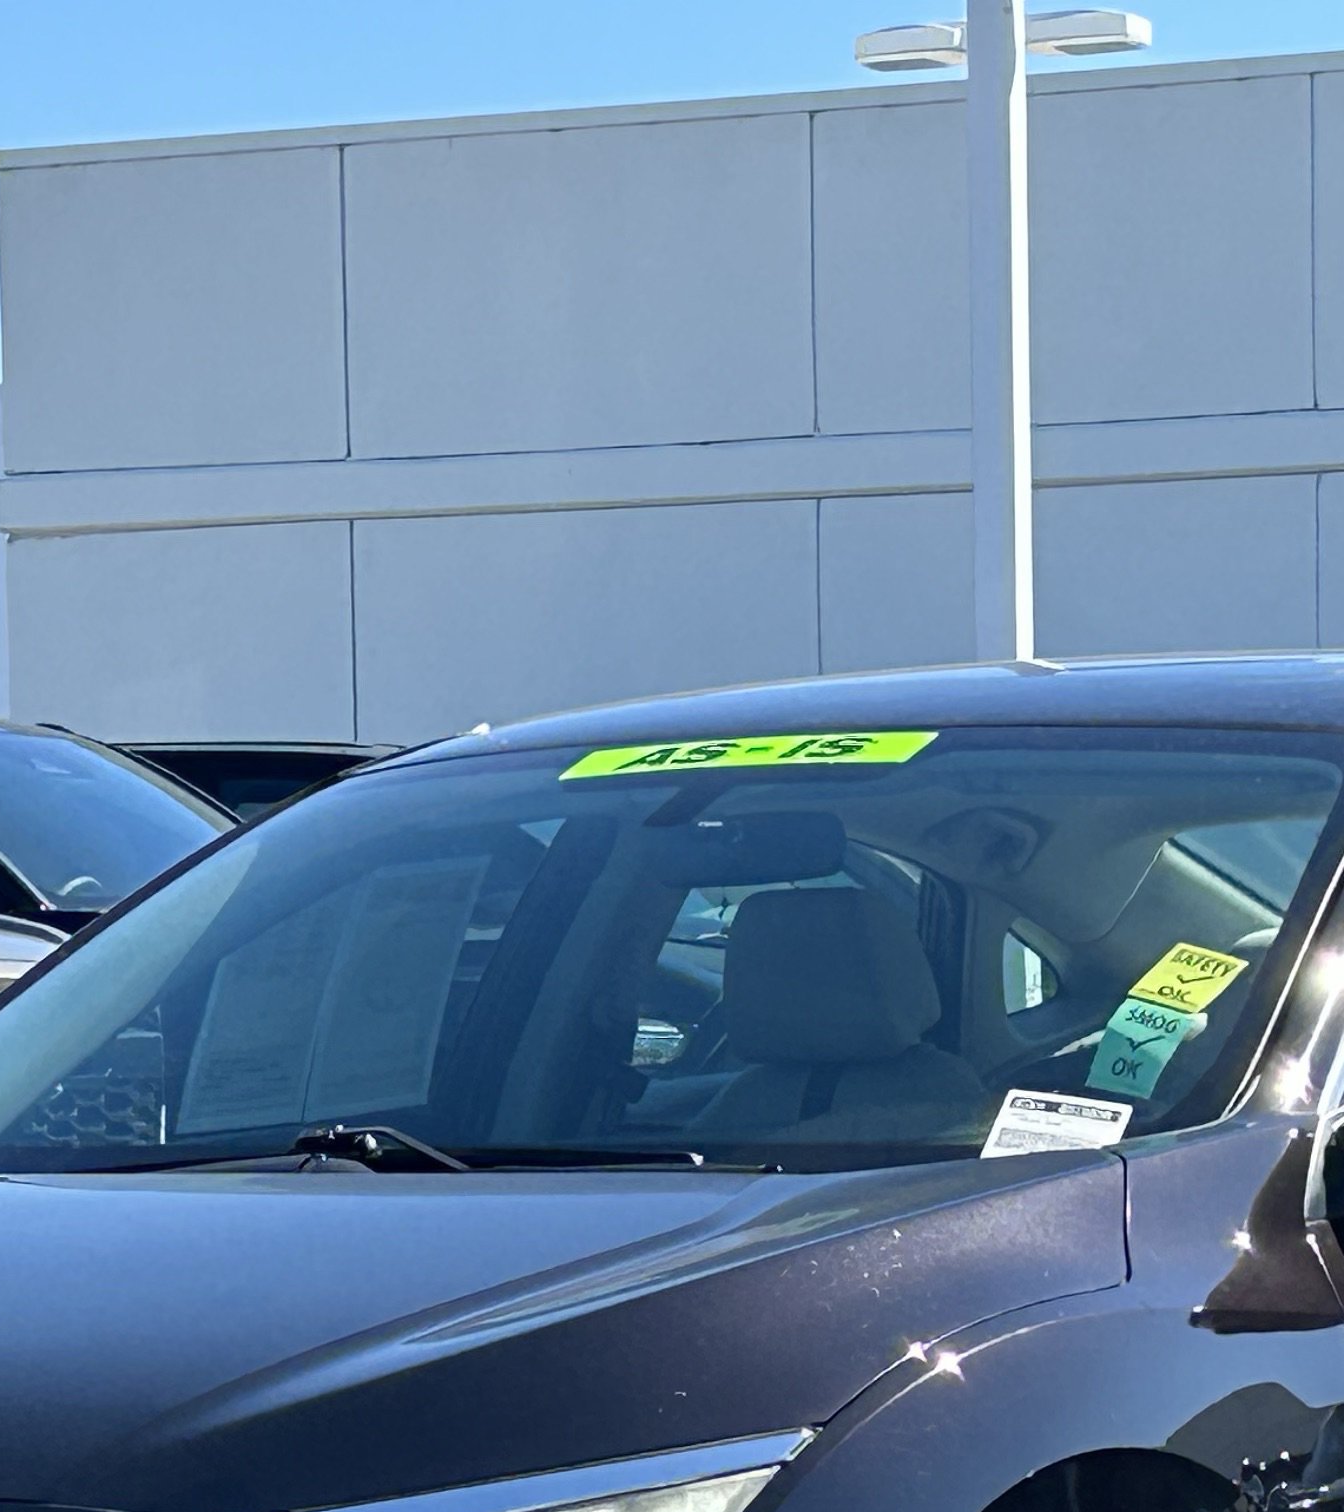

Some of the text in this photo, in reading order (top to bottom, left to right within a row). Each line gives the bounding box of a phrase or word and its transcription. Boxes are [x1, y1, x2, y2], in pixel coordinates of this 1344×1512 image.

[1170, 948, 1239, 977] SAFETY
[1157, 985, 1192, 1002] OK
[1111, 1056, 1144, 1080] OK
